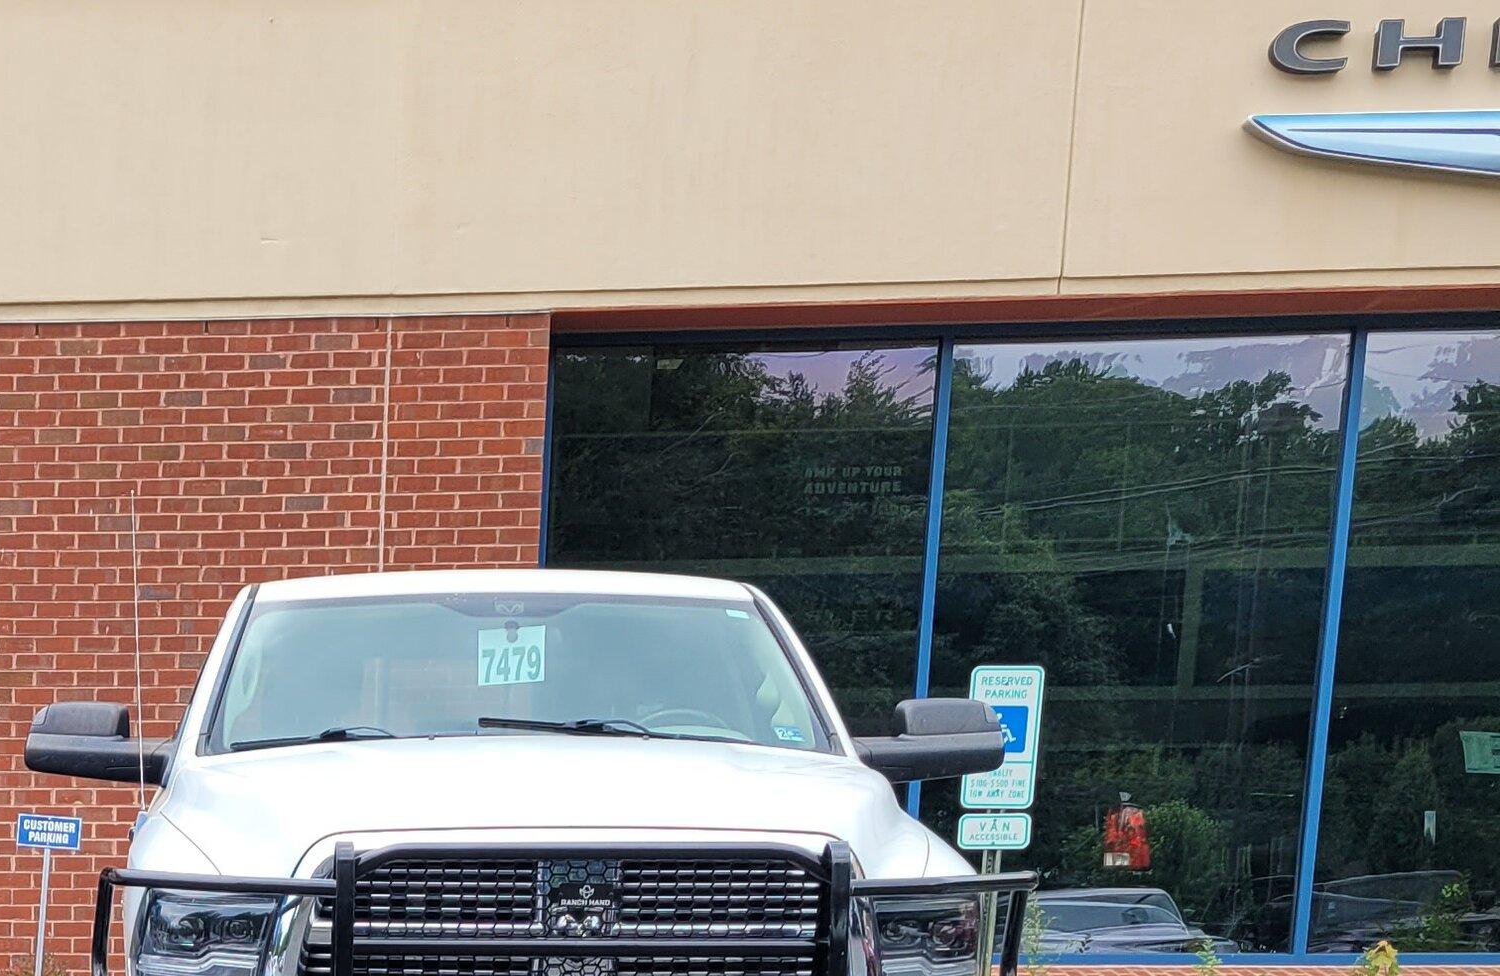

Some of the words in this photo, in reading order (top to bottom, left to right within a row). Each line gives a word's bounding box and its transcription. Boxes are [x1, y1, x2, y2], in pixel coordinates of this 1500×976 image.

[1268, 17, 1500, 75] CH
[842, 466, 861, 478] UP
[864, 465, 902, 477] YOUR
[804, 480, 902, 494] ADVENTURE
[481, 645, 541, 684] 7479
[981, 676, 1033, 686] RESERVED
[984, 689, 1028, 699] PARKING
[23, 819, 76, 833] CUSTOMER
[979, 821, 1011, 832] VAN
[28, 831, 69, 844] PARKING
[969, 833, 1018, 841] ACCESSIBLE
